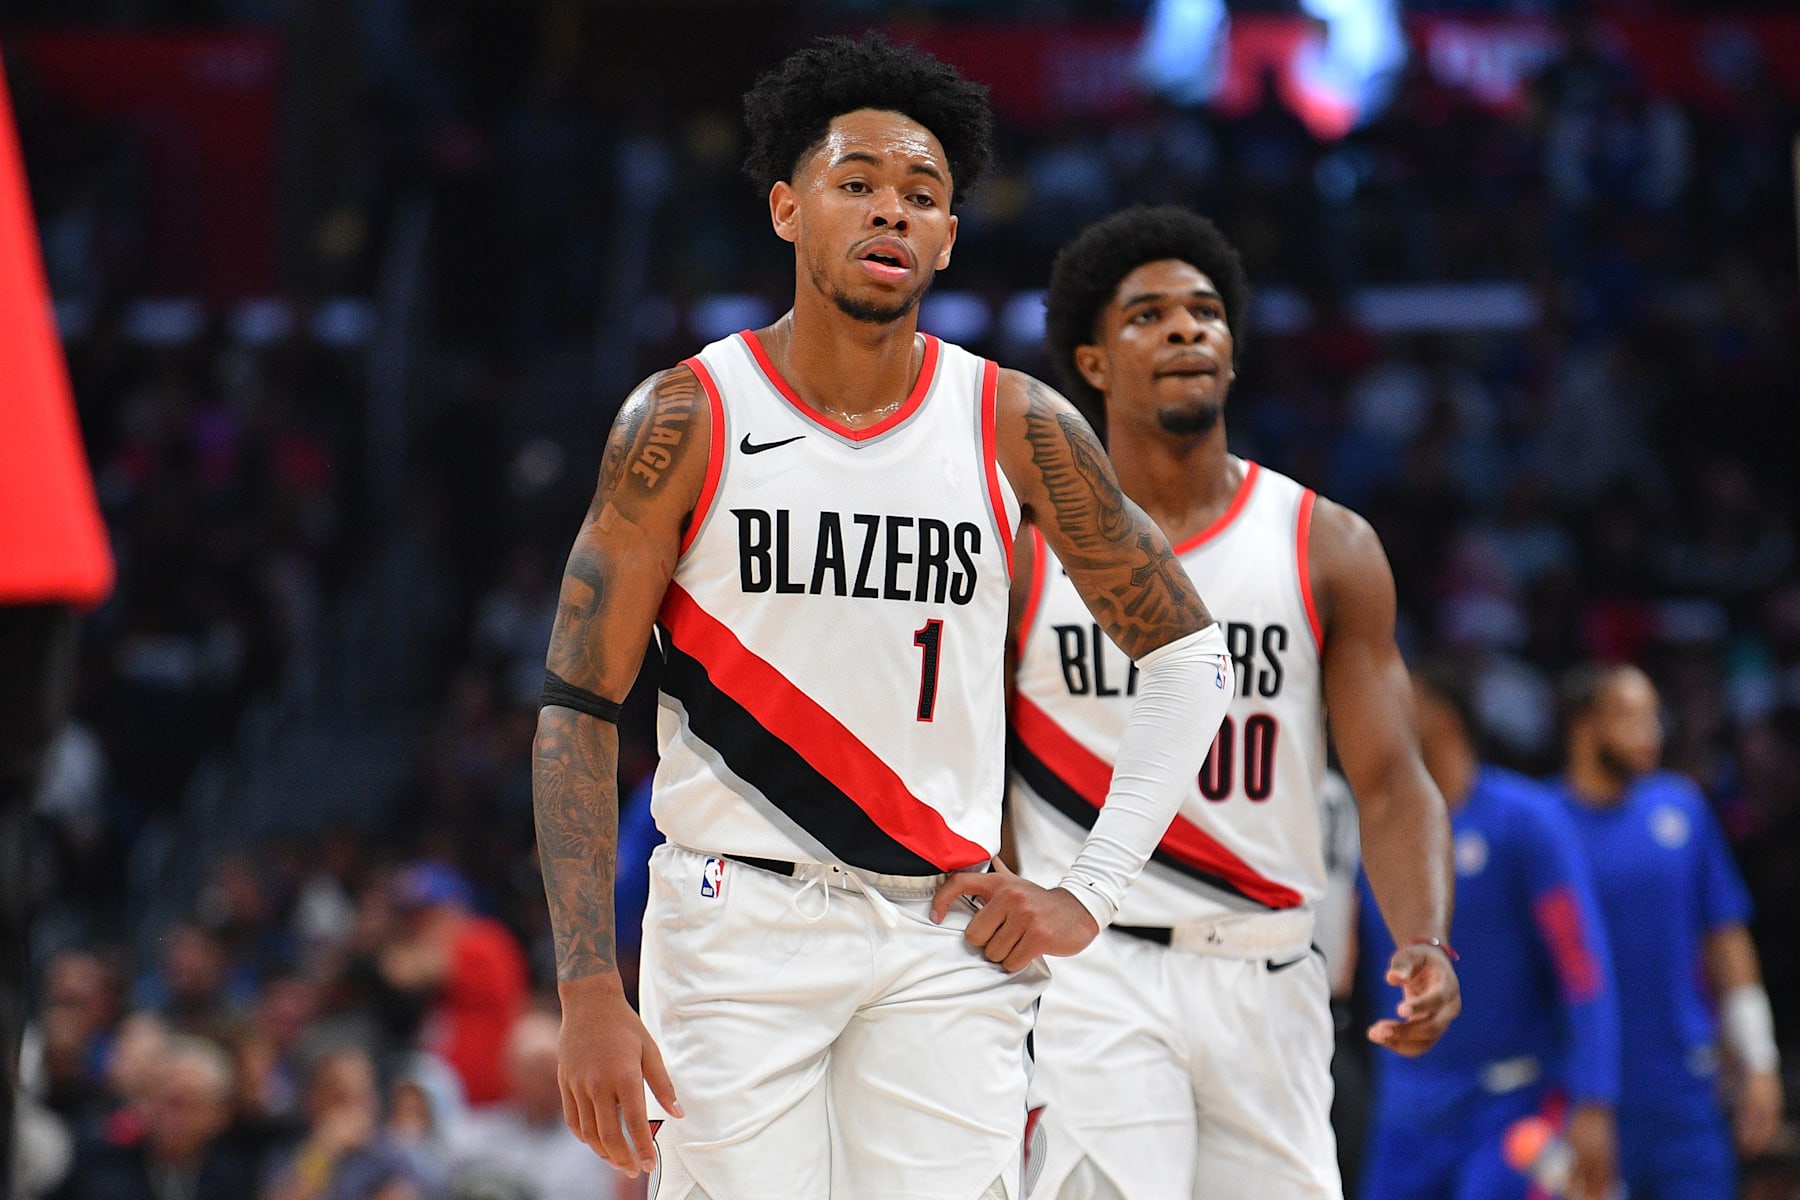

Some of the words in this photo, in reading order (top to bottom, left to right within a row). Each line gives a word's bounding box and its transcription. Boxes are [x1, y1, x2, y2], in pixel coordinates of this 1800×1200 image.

[729, 508, 981, 605] BLAZERS
[914, 618, 944, 722] 1
[1052, 623, 1287, 697] BLRS
[1197, 713, 1279, 802] 00
